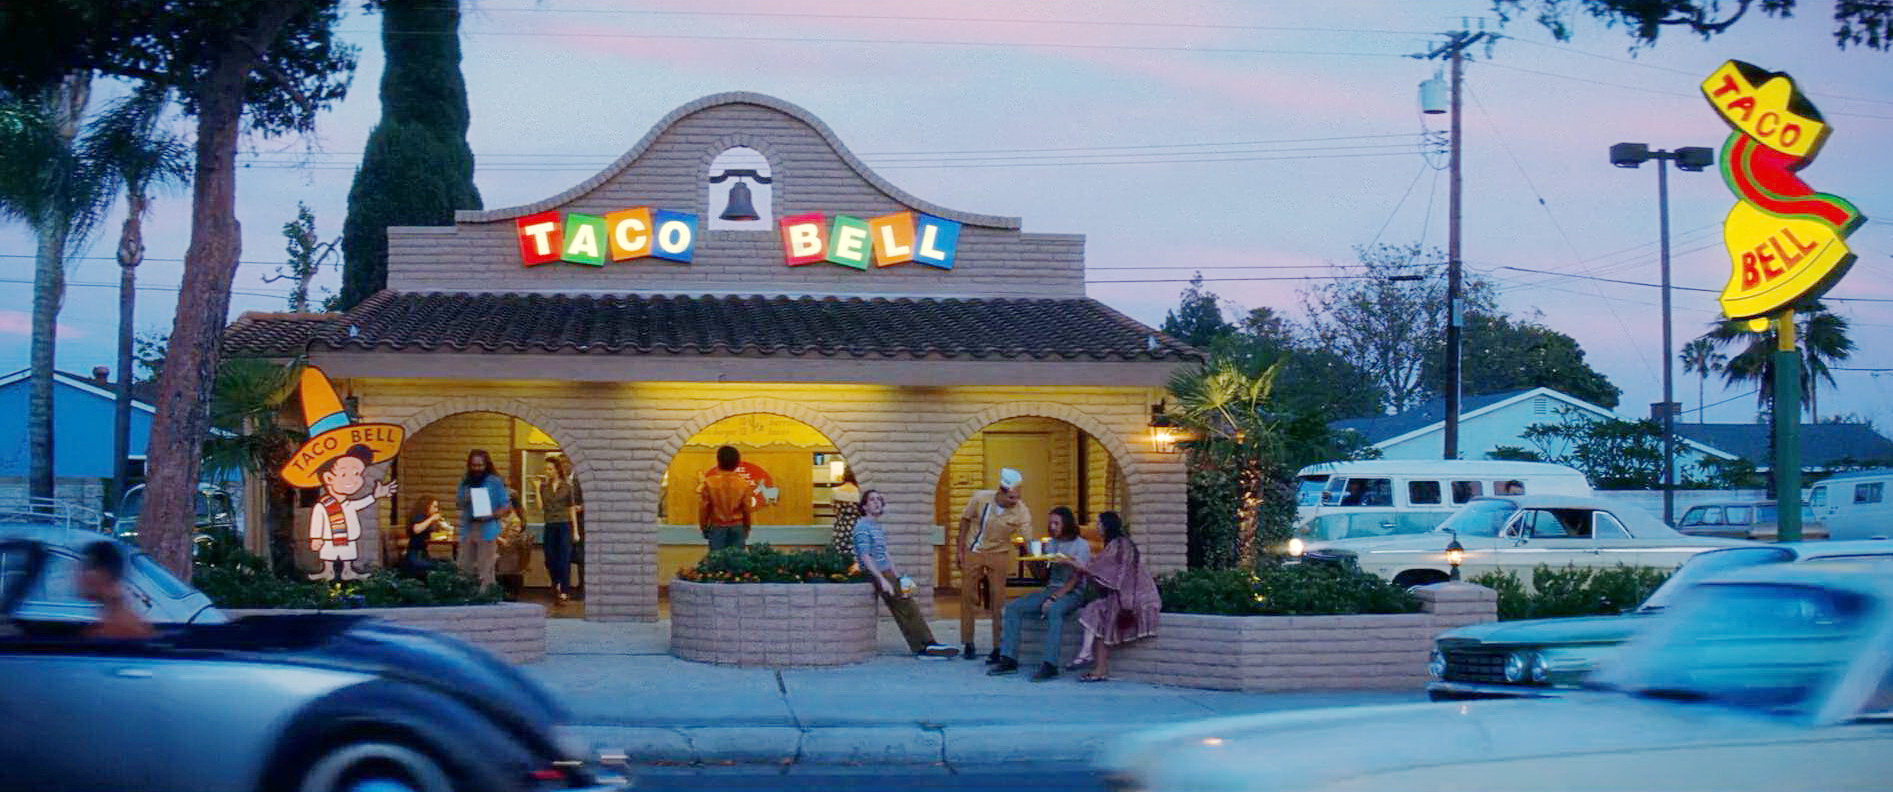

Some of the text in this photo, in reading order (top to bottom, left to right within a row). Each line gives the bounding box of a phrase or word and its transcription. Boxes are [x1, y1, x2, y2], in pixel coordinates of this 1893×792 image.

[1713, 75, 1801, 147] TACO
[525, 219, 946, 261] TACO BELL
[1741, 228, 1818, 292] BELL
[292, 428, 395, 472] TACO BELL
